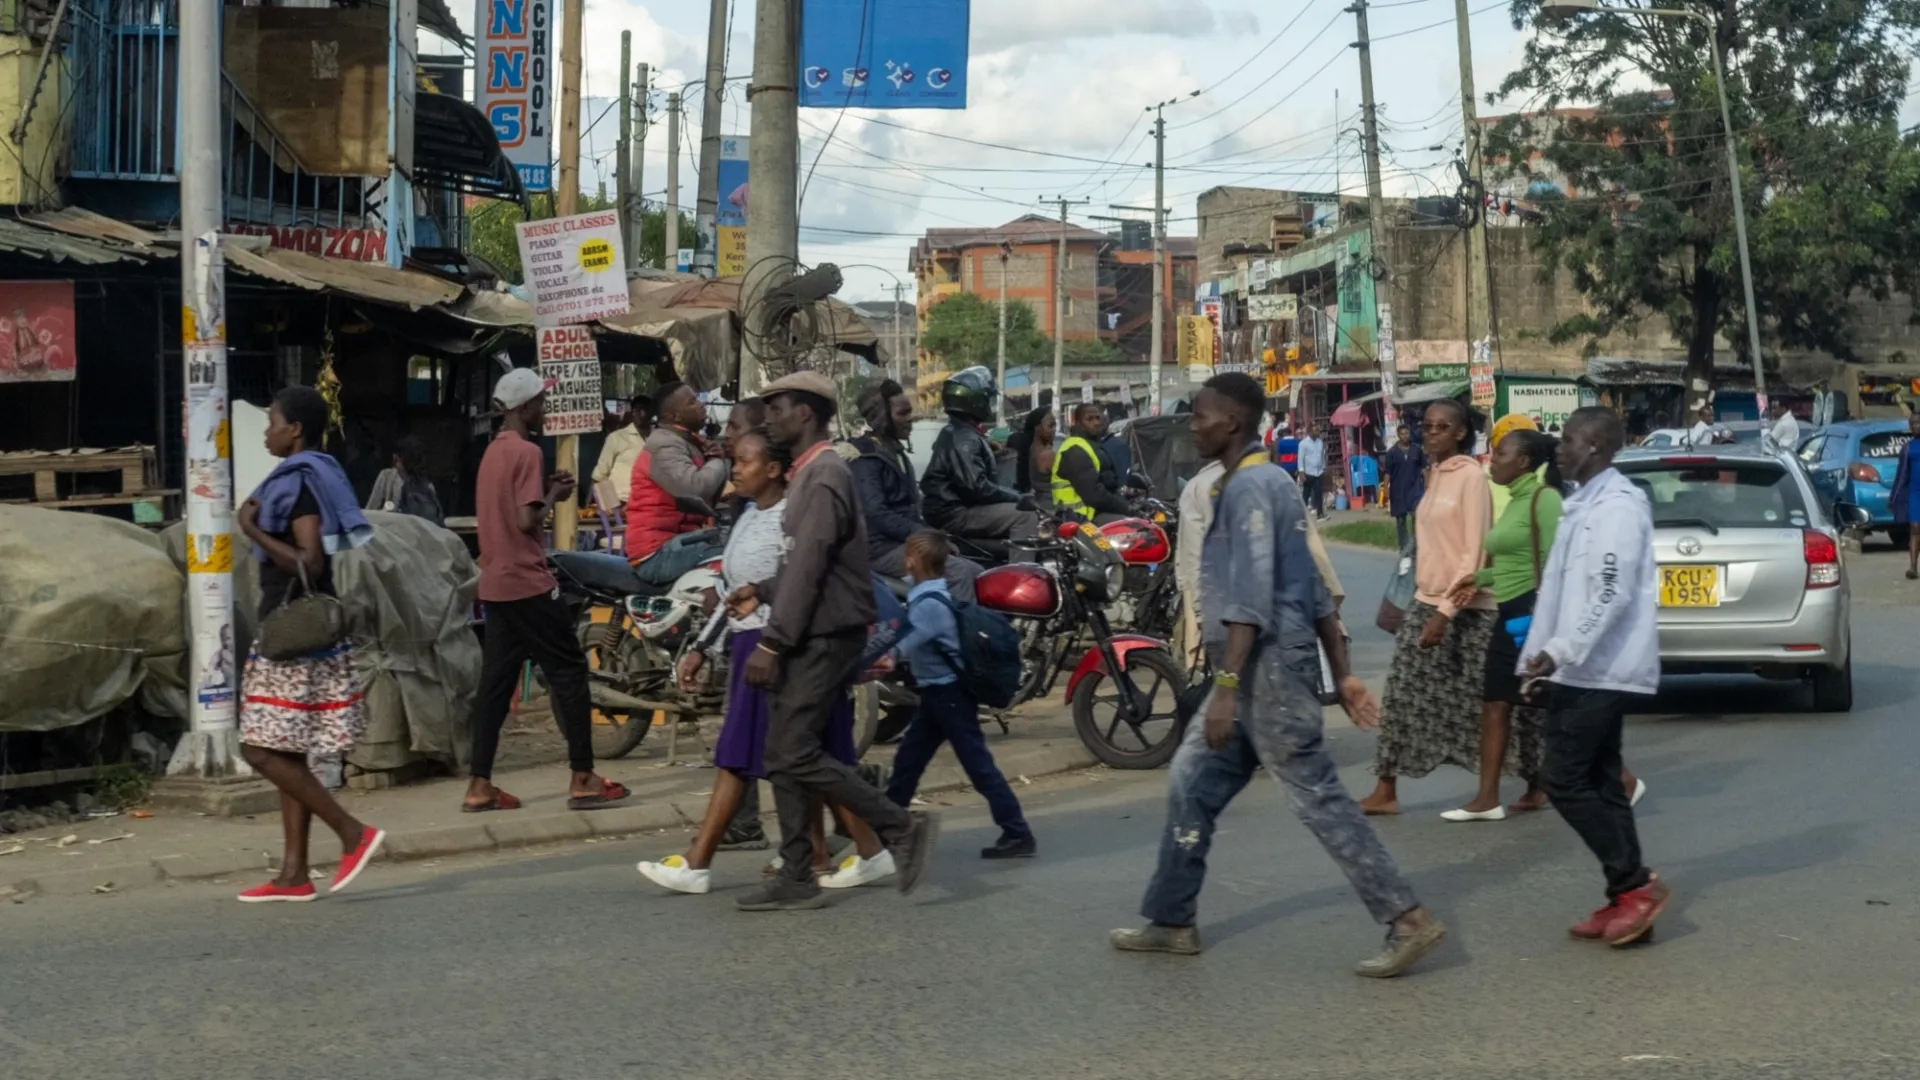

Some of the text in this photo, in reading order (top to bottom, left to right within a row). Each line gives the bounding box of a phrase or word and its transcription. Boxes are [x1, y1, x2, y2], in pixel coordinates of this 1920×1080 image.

[531, 0, 546, 137] CHOOL
[523, 214, 616, 238] MUSIC CLASSES
[529, 238, 557, 250] PIANO
[531, 251, 563, 263] GUITAR
[584, 256, 609, 268] EXAMS
[531, 264, 563, 276] VIOLIN
[535, 276, 569, 289] VOCALS
[537, 286, 589, 303] SAXOPHONE
[541, 343, 597, 360] SCHOOL
[542, 362, 600, 379] KCPE/KCSE
[1514, 387, 1566, 397] NASHATECH
[545, 396, 601, 413] BEGINNERS
[1664, 569, 1701, 587] KCU
[1667, 587, 1715, 604] 195Y
